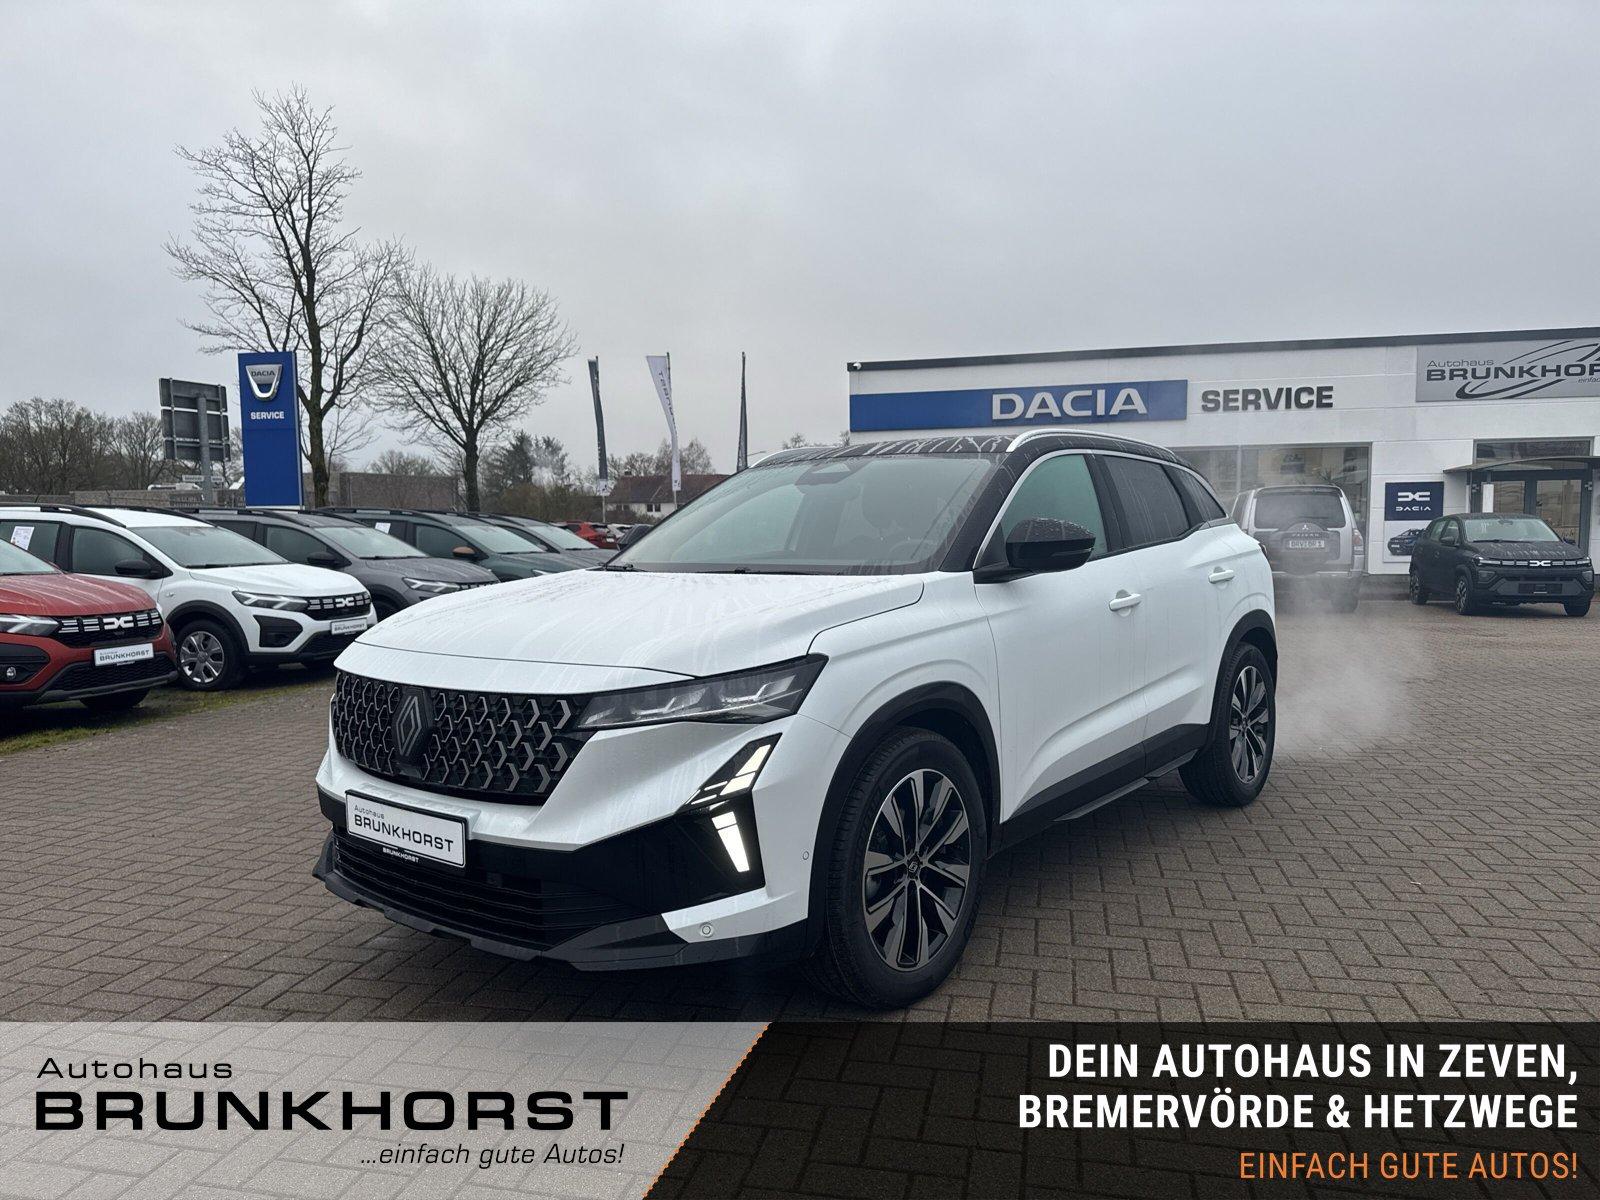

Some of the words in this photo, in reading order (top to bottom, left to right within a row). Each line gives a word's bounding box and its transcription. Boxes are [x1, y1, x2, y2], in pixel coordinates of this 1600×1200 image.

[1427, 359, 1494, 368] Autohaus
[991, 387, 1148, 420] DACIA
[1201, 385, 1334, 413] SERVICE
[250, 411, 285, 420] SERVICE
[99, 649, 150, 662] BRUNKHORST
[354, 804, 385, 820] Autohaus
[354, 814, 454, 853] BRUNKHORST
[382, 847, 419, 863] BRUNKHORST
